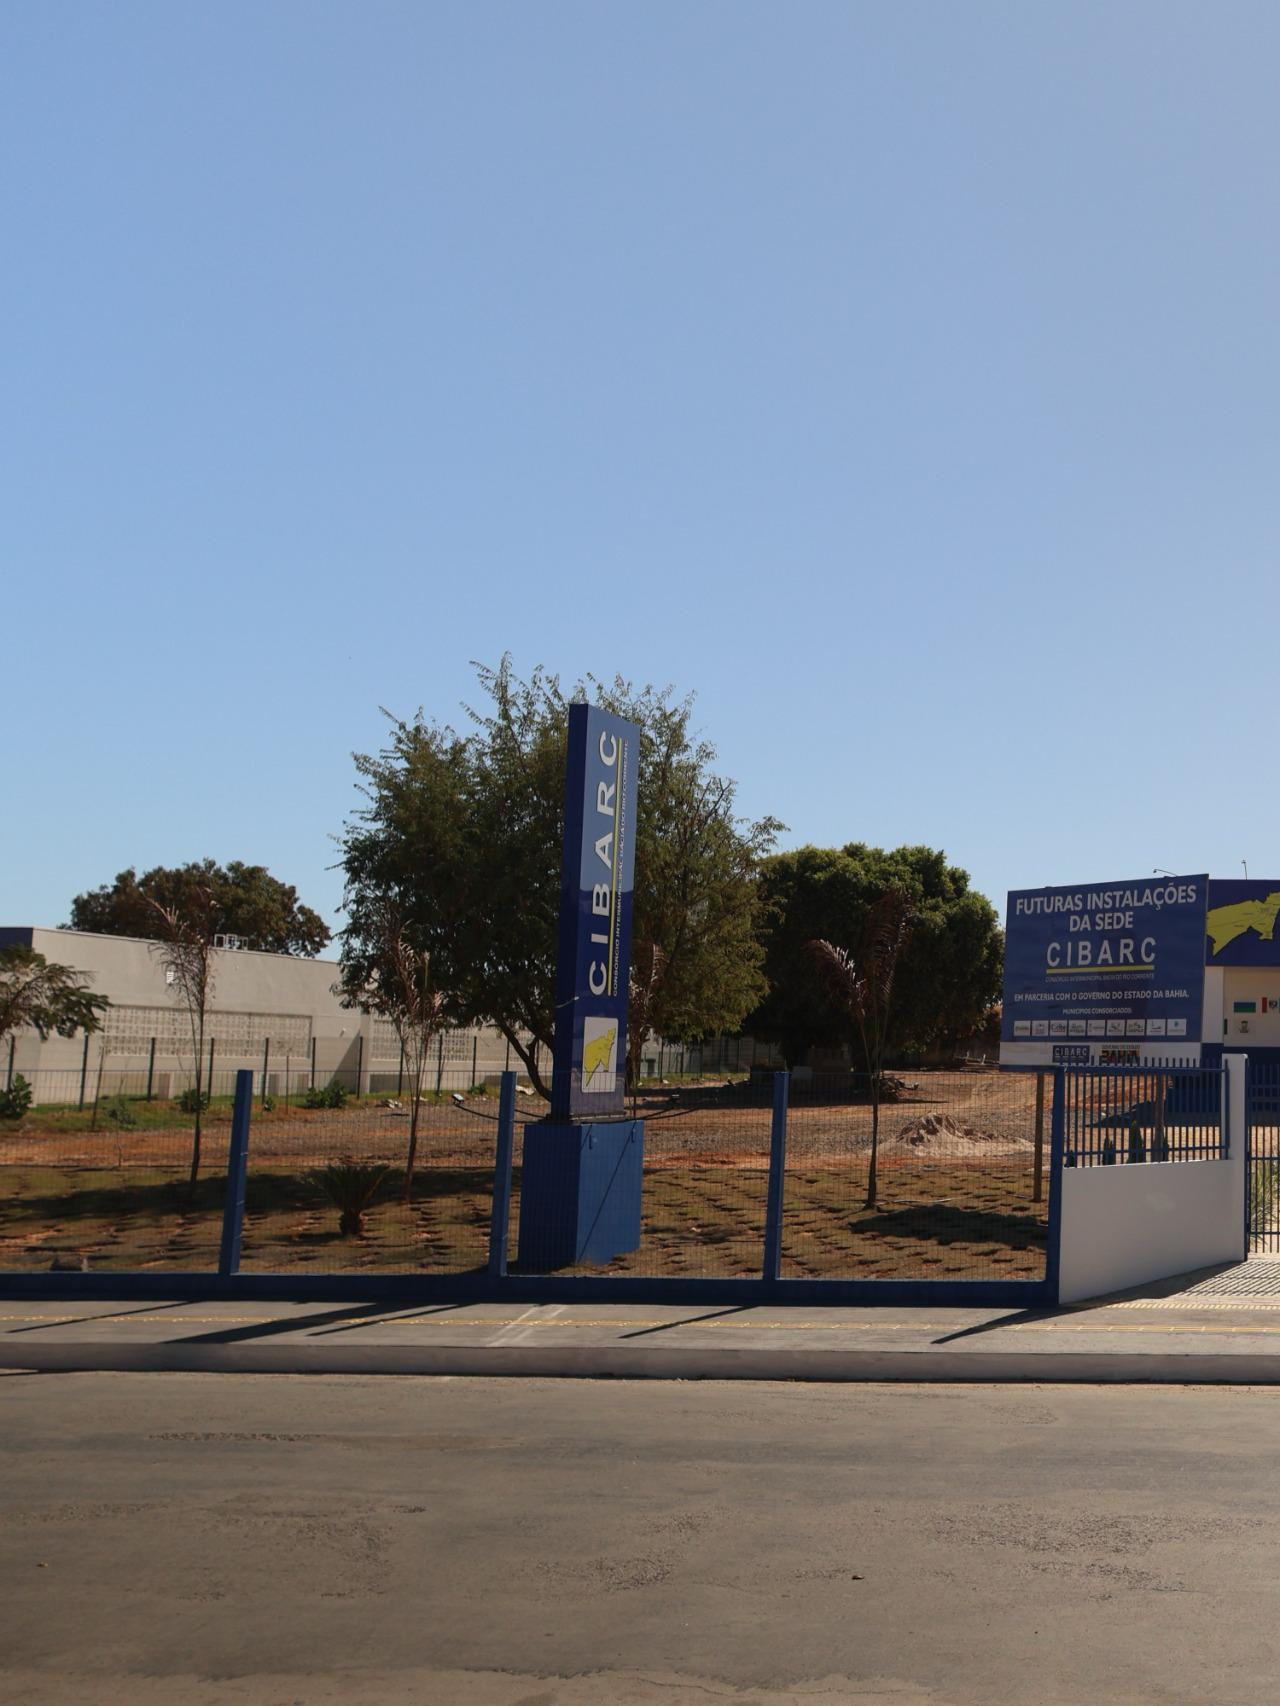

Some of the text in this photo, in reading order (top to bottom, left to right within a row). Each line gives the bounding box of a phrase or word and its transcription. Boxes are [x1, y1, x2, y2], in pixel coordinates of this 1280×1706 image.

[589, 731, 617, 995] CIBARC
[1016, 882, 1197, 915] FUTURAS INSTALAÇÕES
[1069, 911, 1134, 932] DA SEDE
[1046, 937, 1157, 967] CIBARC
[1024, 992, 1054, 1001] PARCERIA
[1055, 992, 1070, 1001] COM
[1071, 992, 1077, 1000] O
[1078, 991, 1111, 1000] GOVERNO
[1112, 991, 1123, 1000] DO
[1124, 990, 1152, 999] ESTADO
[1153, 990, 1164, 998] DA
